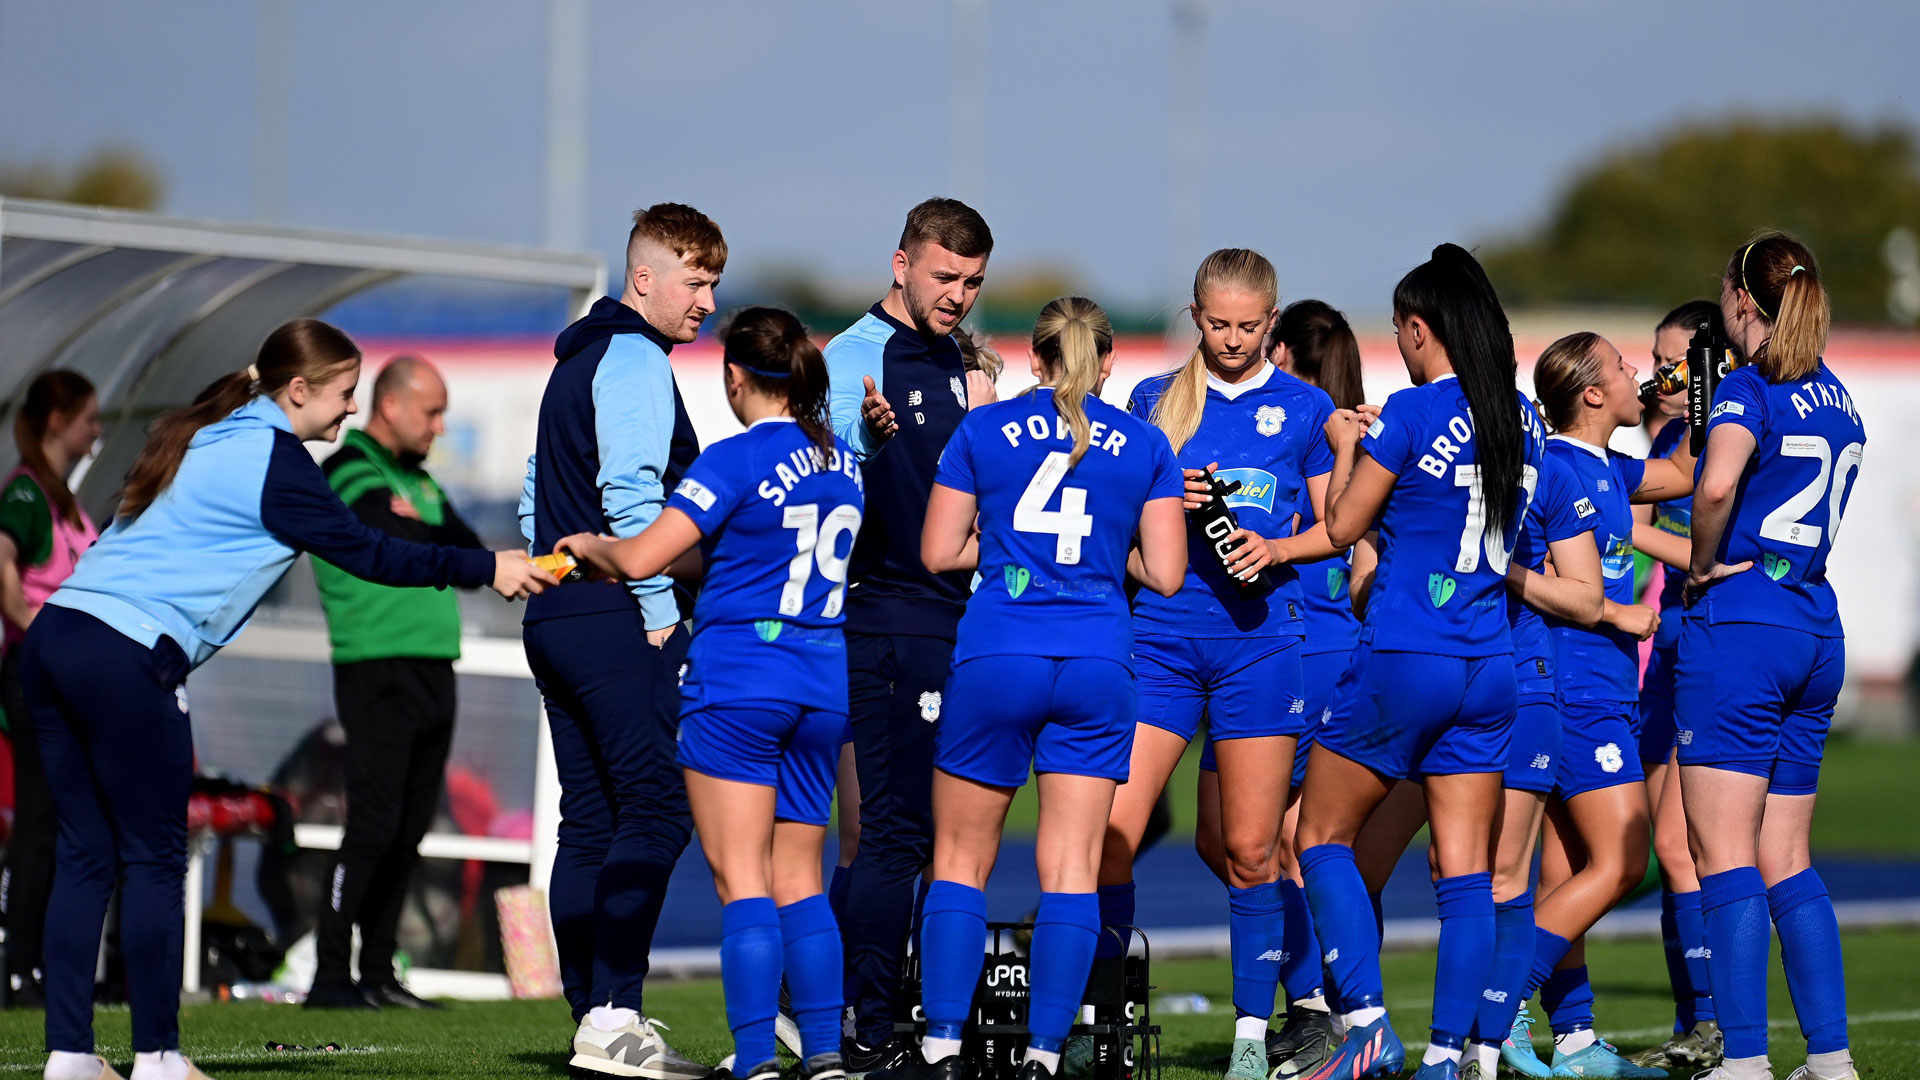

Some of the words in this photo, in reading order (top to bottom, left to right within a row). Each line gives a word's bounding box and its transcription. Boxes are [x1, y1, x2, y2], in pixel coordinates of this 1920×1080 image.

[914, 411, 926, 425] ID
[1694, 375, 1702, 426] HYDRATE
[1790, 381, 1859, 426] ATKINS
[758, 445, 866, 507] SAUNDER
[1759, 435, 1864, 548] 20
[1013, 451, 1094, 565] 4
[778, 503, 863, 619] 19
